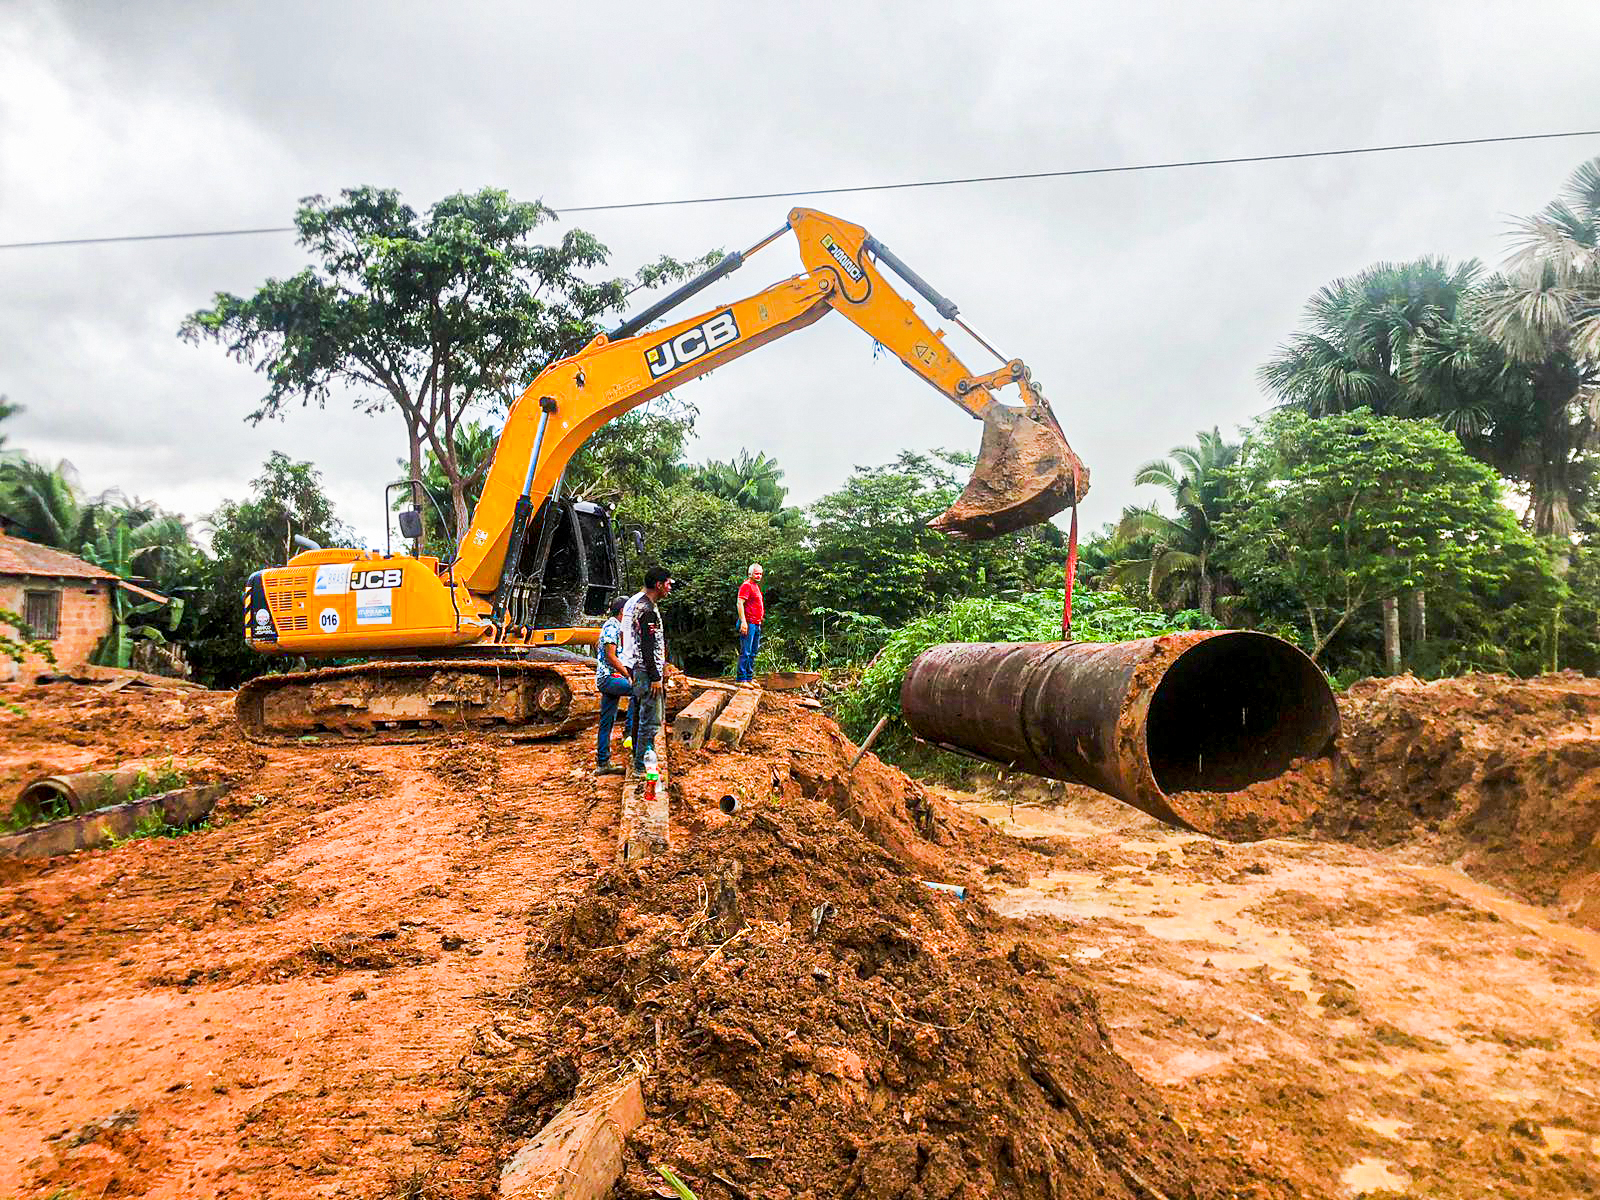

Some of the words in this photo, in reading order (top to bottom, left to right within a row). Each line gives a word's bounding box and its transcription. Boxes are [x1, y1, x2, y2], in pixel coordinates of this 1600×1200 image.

[650, 313, 737, 376] JCB
[350, 569, 402, 589] JCB
[321, 614, 338, 627] 016
